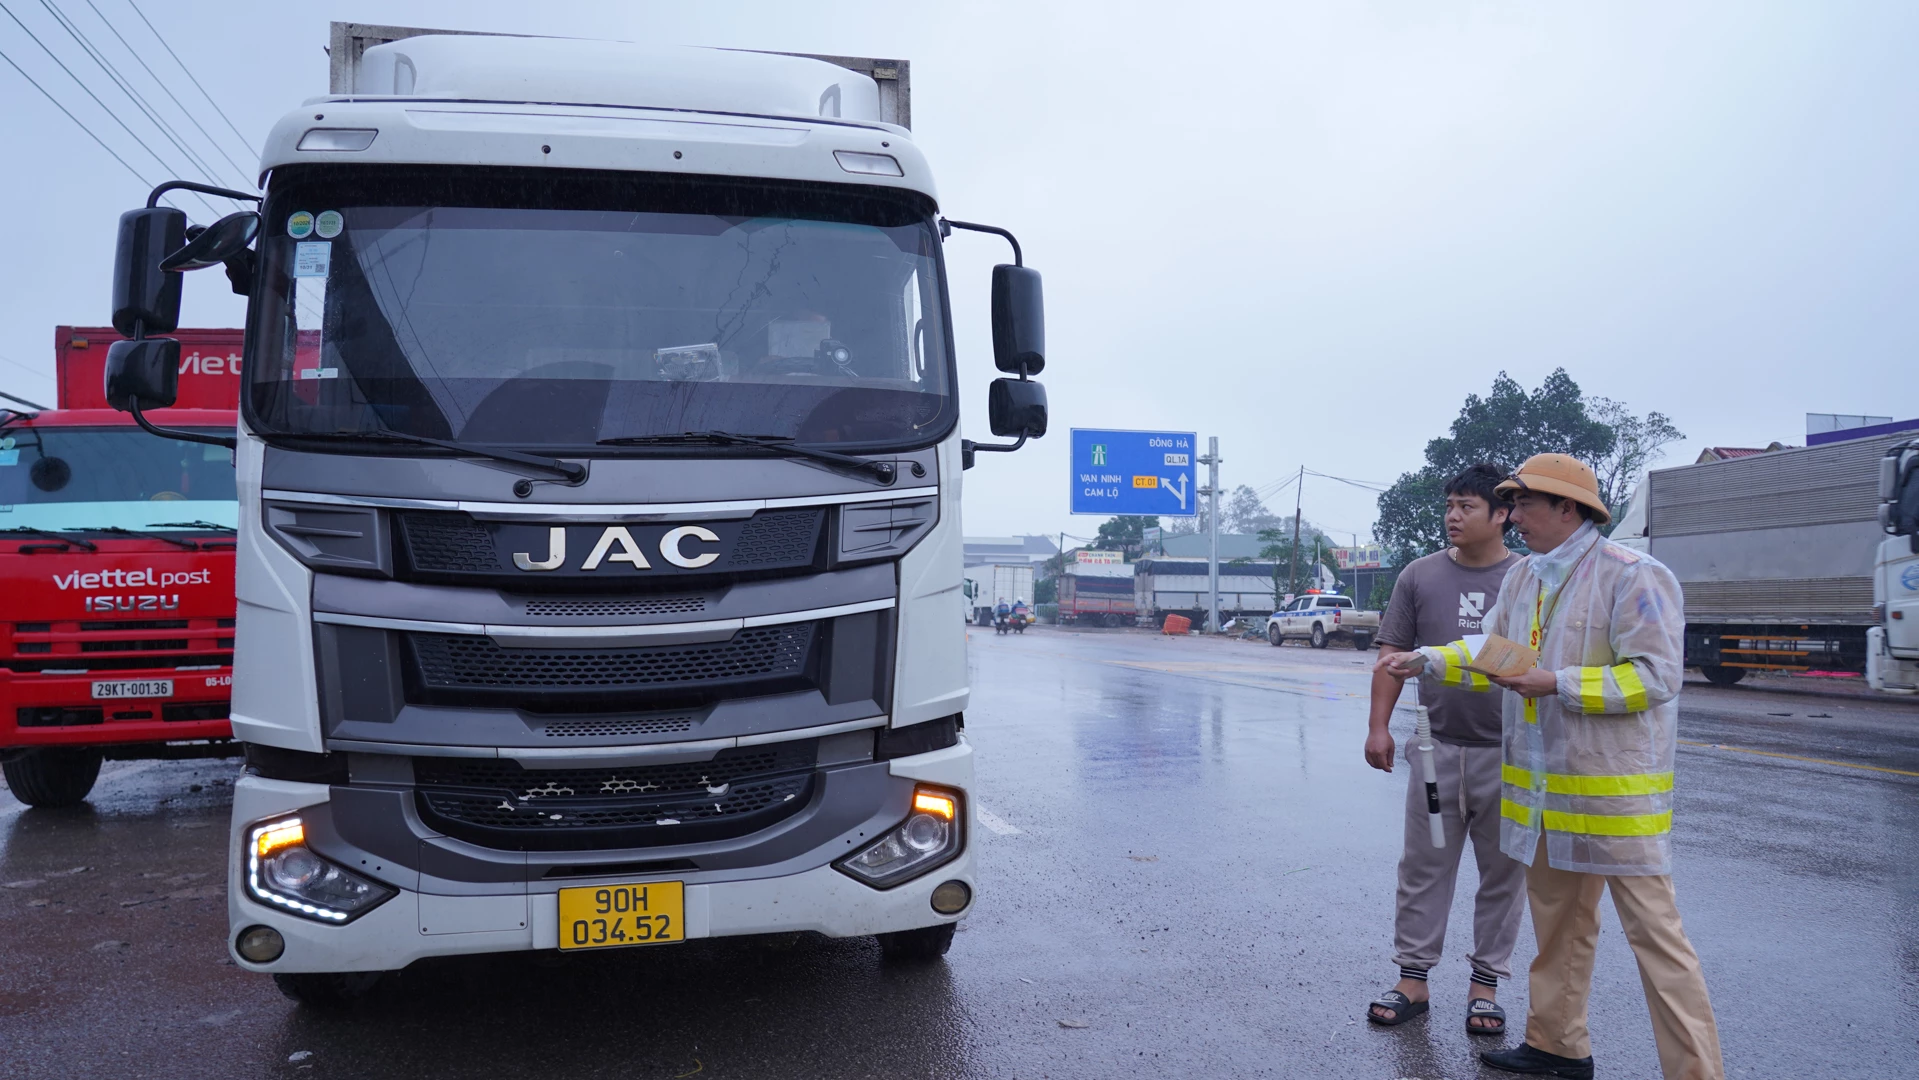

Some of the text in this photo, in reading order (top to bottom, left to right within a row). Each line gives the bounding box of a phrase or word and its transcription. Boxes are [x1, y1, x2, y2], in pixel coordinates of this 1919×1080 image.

[1149, 437, 1189, 448] ĐÔNG HÀ
[1165, 455, 1187, 464] QL.1A
[1080, 474, 1122, 485] VẠN NINH
[1135, 478, 1156, 486] CT.01
[1084, 487, 1119, 499] CAM LỘ
[512, 525, 720, 572] JAC
[53, 567, 211, 590] viettel post
[85, 594, 180, 612] ISUZU
[205, 676, 232, 687] 05-LO
[596, 887, 648, 914] 90H
[573, 914, 671, 945] 034.52
[1475, 1000, 1495, 1010] NIKE
